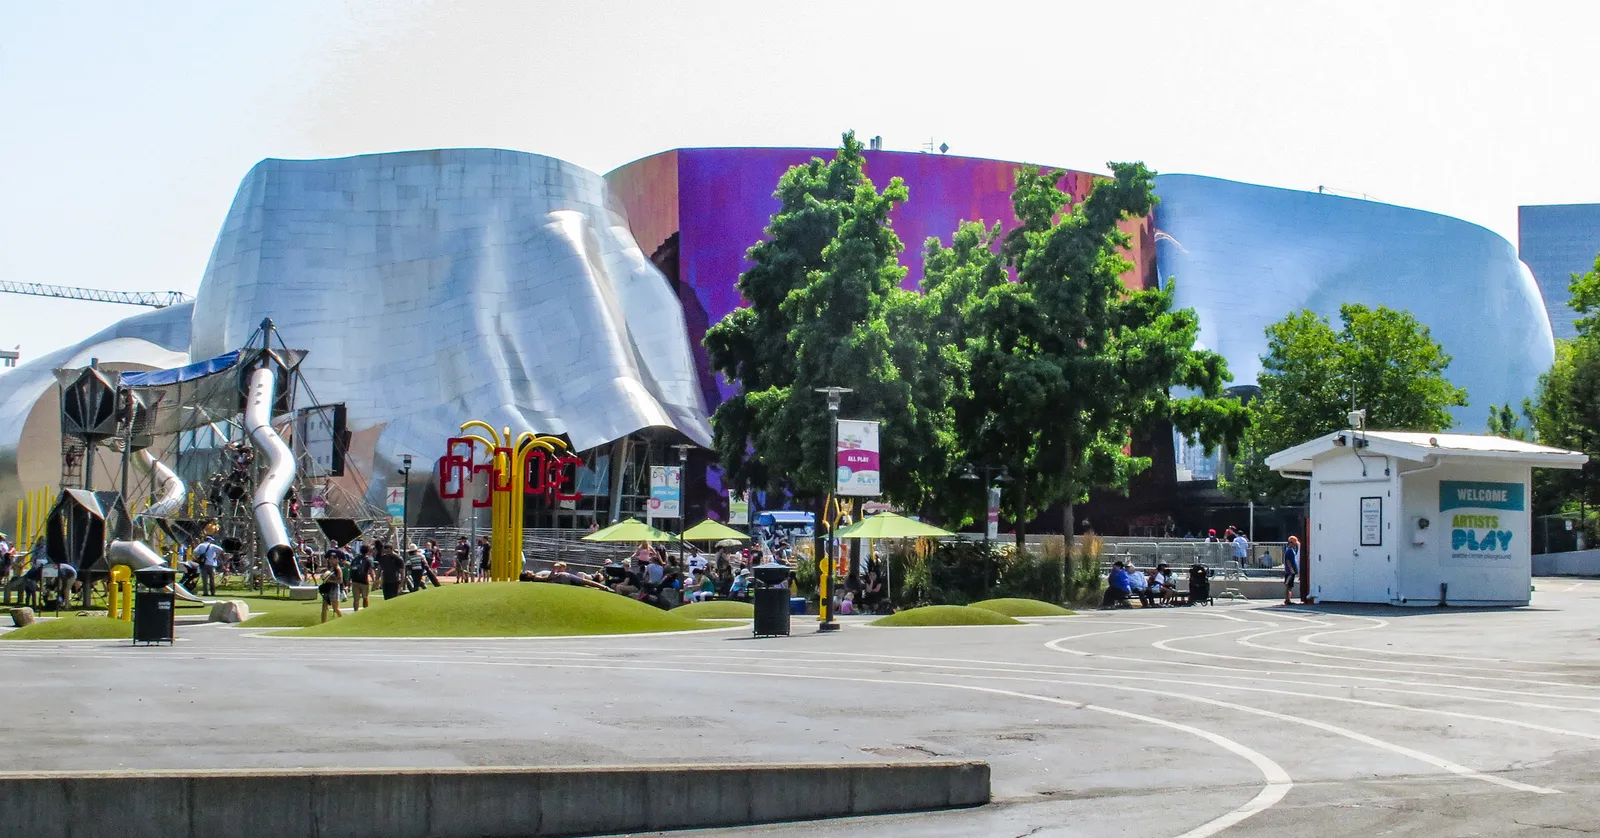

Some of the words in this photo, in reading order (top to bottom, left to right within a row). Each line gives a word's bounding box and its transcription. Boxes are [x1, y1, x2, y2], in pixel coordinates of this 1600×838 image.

[1457, 488, 1508, 502] WELCOME
[1452, 514, 1499, 528] ARTISTS
[1452, 529, 1513, 551] PLAY
[1484, 553, 1512, 561] playground
